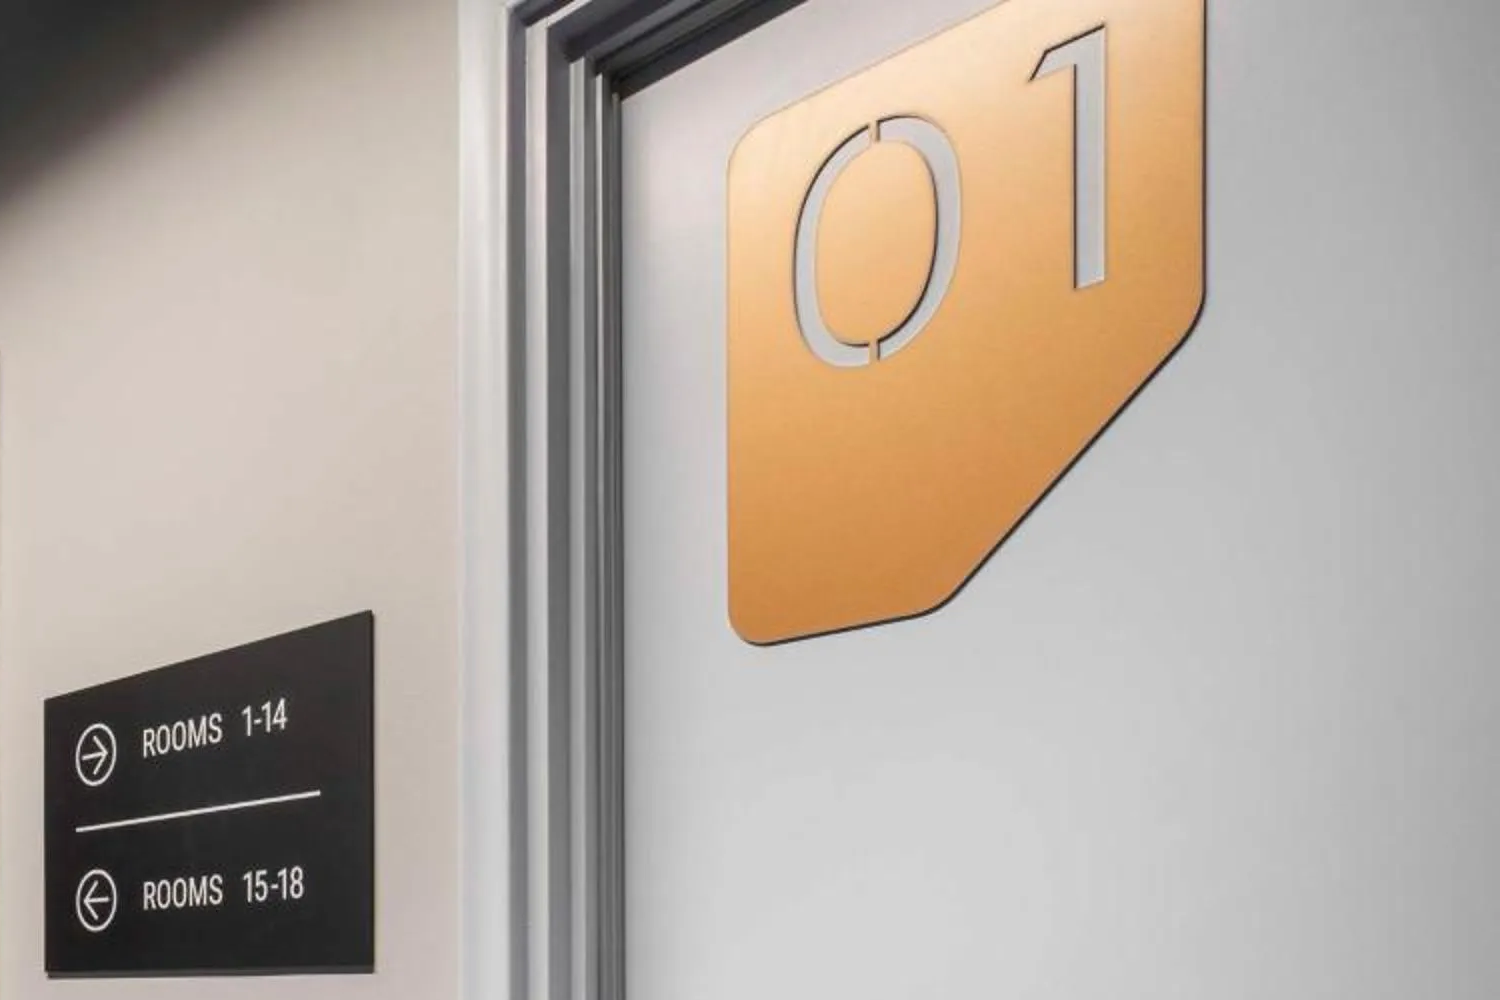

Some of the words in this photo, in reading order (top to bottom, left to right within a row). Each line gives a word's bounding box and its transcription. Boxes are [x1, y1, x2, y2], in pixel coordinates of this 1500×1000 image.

[792, 22, 1107, 368] 01
[142, 713, 223, 758] ROOMS
[242, 698, 288, 736] 1-14
[142, 874, 224, 910] ROOMS
[243, 866, 305, 902] 15-18
